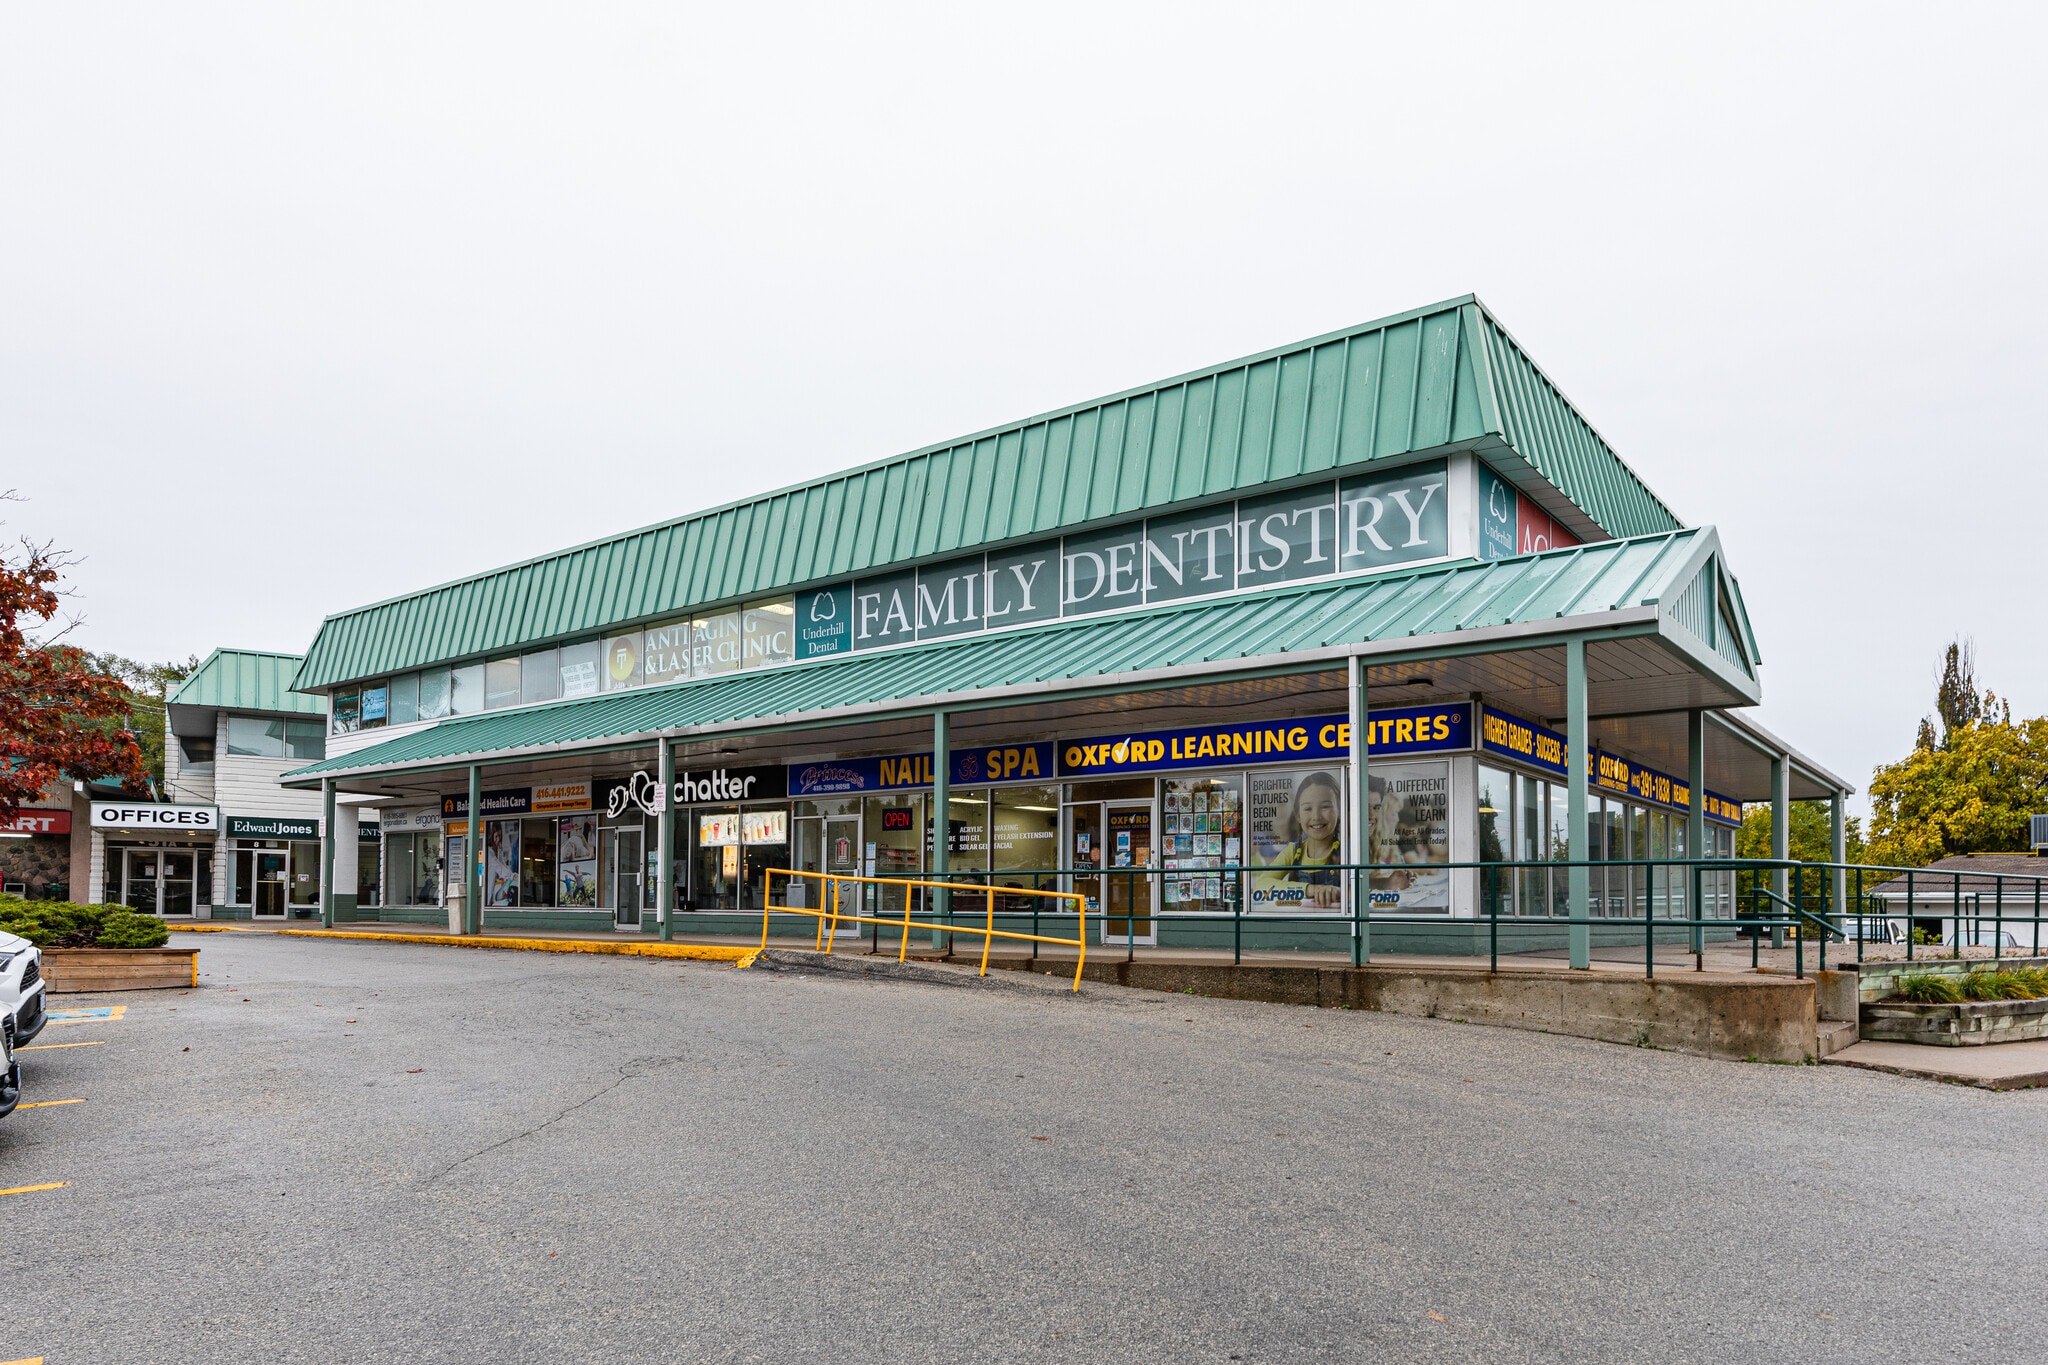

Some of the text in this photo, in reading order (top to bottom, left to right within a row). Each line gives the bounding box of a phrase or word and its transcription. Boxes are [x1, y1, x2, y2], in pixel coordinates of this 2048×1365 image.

[1484, 517, 1513, 551] Underhill
[857, 482, 1444, 640] FAMILY DENTISTRY
[645, 612, 757, 653] ANTI AGING
[802, 622, 845, 641] Underhill
[716, 631, 787, 662] CLINIC
[808, 638, 838, 655] Dental
[1065, 738, 1165, 767] OXFORD
[1171, 727, 1309, 760] LEARNING
[1483, 713, 1508, 747] HIGHER
[1508, 722, 1533, 755] GRADES
[1536, 733, 1561, 765] SUCCESS
[879, 747, 1040, 786] NAIL SPA
[1599, 755, 1629, 783] OXFORD
[673, 768, 757, 802] chatter
[800, 764, 865, 793] Princess
[1253, 778, 1293, 792] BRIGHTER
[1387, 777, 1447, 793] A DIFFERENT
[536, 785, 586, 799] 416.441.9222
[1253, 792, 1289, 805] FUTURES
[1409, 792, 1446, 807] WAY TO
[456, 796, 526, 812] Balaed Health Care
[101, 808, 210, 825] OFFICES
[884, 812, 910, 828] OPEN
[1111, 815, 1150, 825] OXFORD
[1253, 807, 1277, 819] BEGIN
[1415, 808, 1446, 822] LEARN
[358, 828, 381, 837] ENTS
[959, 825, 984, 833] ACRYLIC
[993, 823, 1019, 832] WAXING
[1253, 820, 1273, 832] HERE
[959, 834, 969, 842] BIO
[970, 834, 981, 842] GEL
[993, 831, 1054, 841] EYELASH EXTENSION
[959, 843, 978, 851] SOLAR
[1253, 886, 1305, 902] OXFORD
[1368, 893, 1400, 903] FORD
